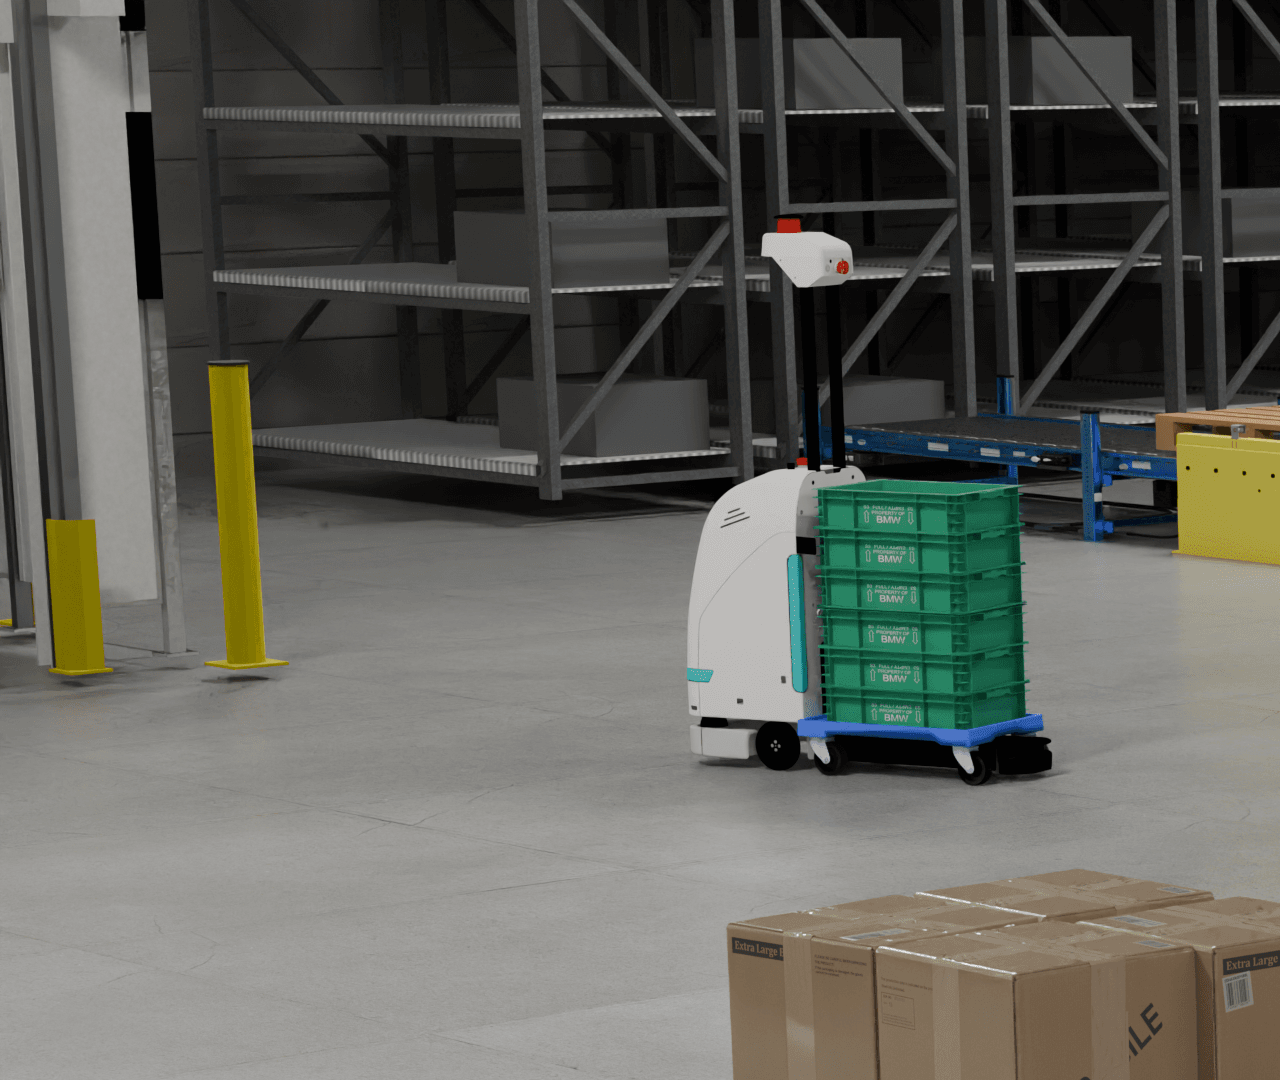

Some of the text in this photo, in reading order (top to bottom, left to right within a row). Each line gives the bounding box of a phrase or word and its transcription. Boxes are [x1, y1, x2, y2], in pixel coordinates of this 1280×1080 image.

[876, 515, 901, 524] BMW
[878, 555, 902, 563] BMW
[880, 594, 904, 603] BMW
[881, 635, 905, 644] BMW
[883, 674, 907, 683] BMW
[884, 714, 909, 723] BMW
[735, 940, 754, 952] Extra
[756, 944, 778, 958] Large
[1226, 960, 1250, 971] Extra
[1253, 955, 1278, 966] Large
